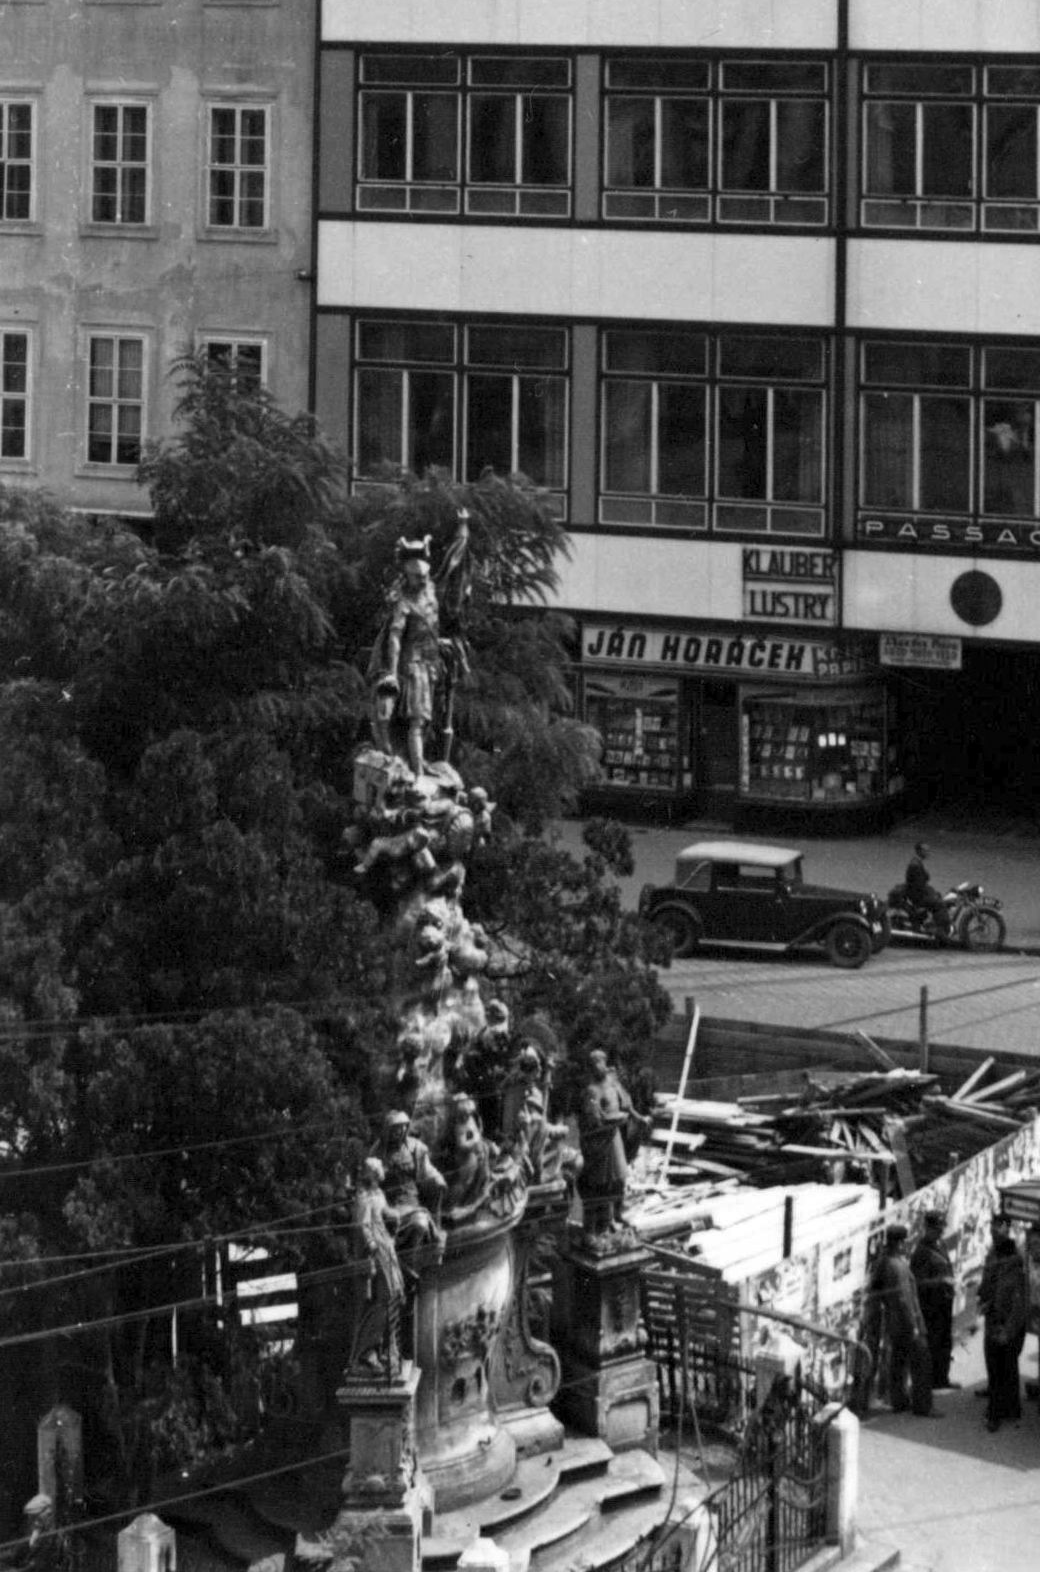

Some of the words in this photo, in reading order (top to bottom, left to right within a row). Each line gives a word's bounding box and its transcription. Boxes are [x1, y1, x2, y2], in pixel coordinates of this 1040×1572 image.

[743, 547, 838, 578] KLAUBER
[750, 589, 831, 619] LUSTRY
[588, 627, 647, 659] JÁN
